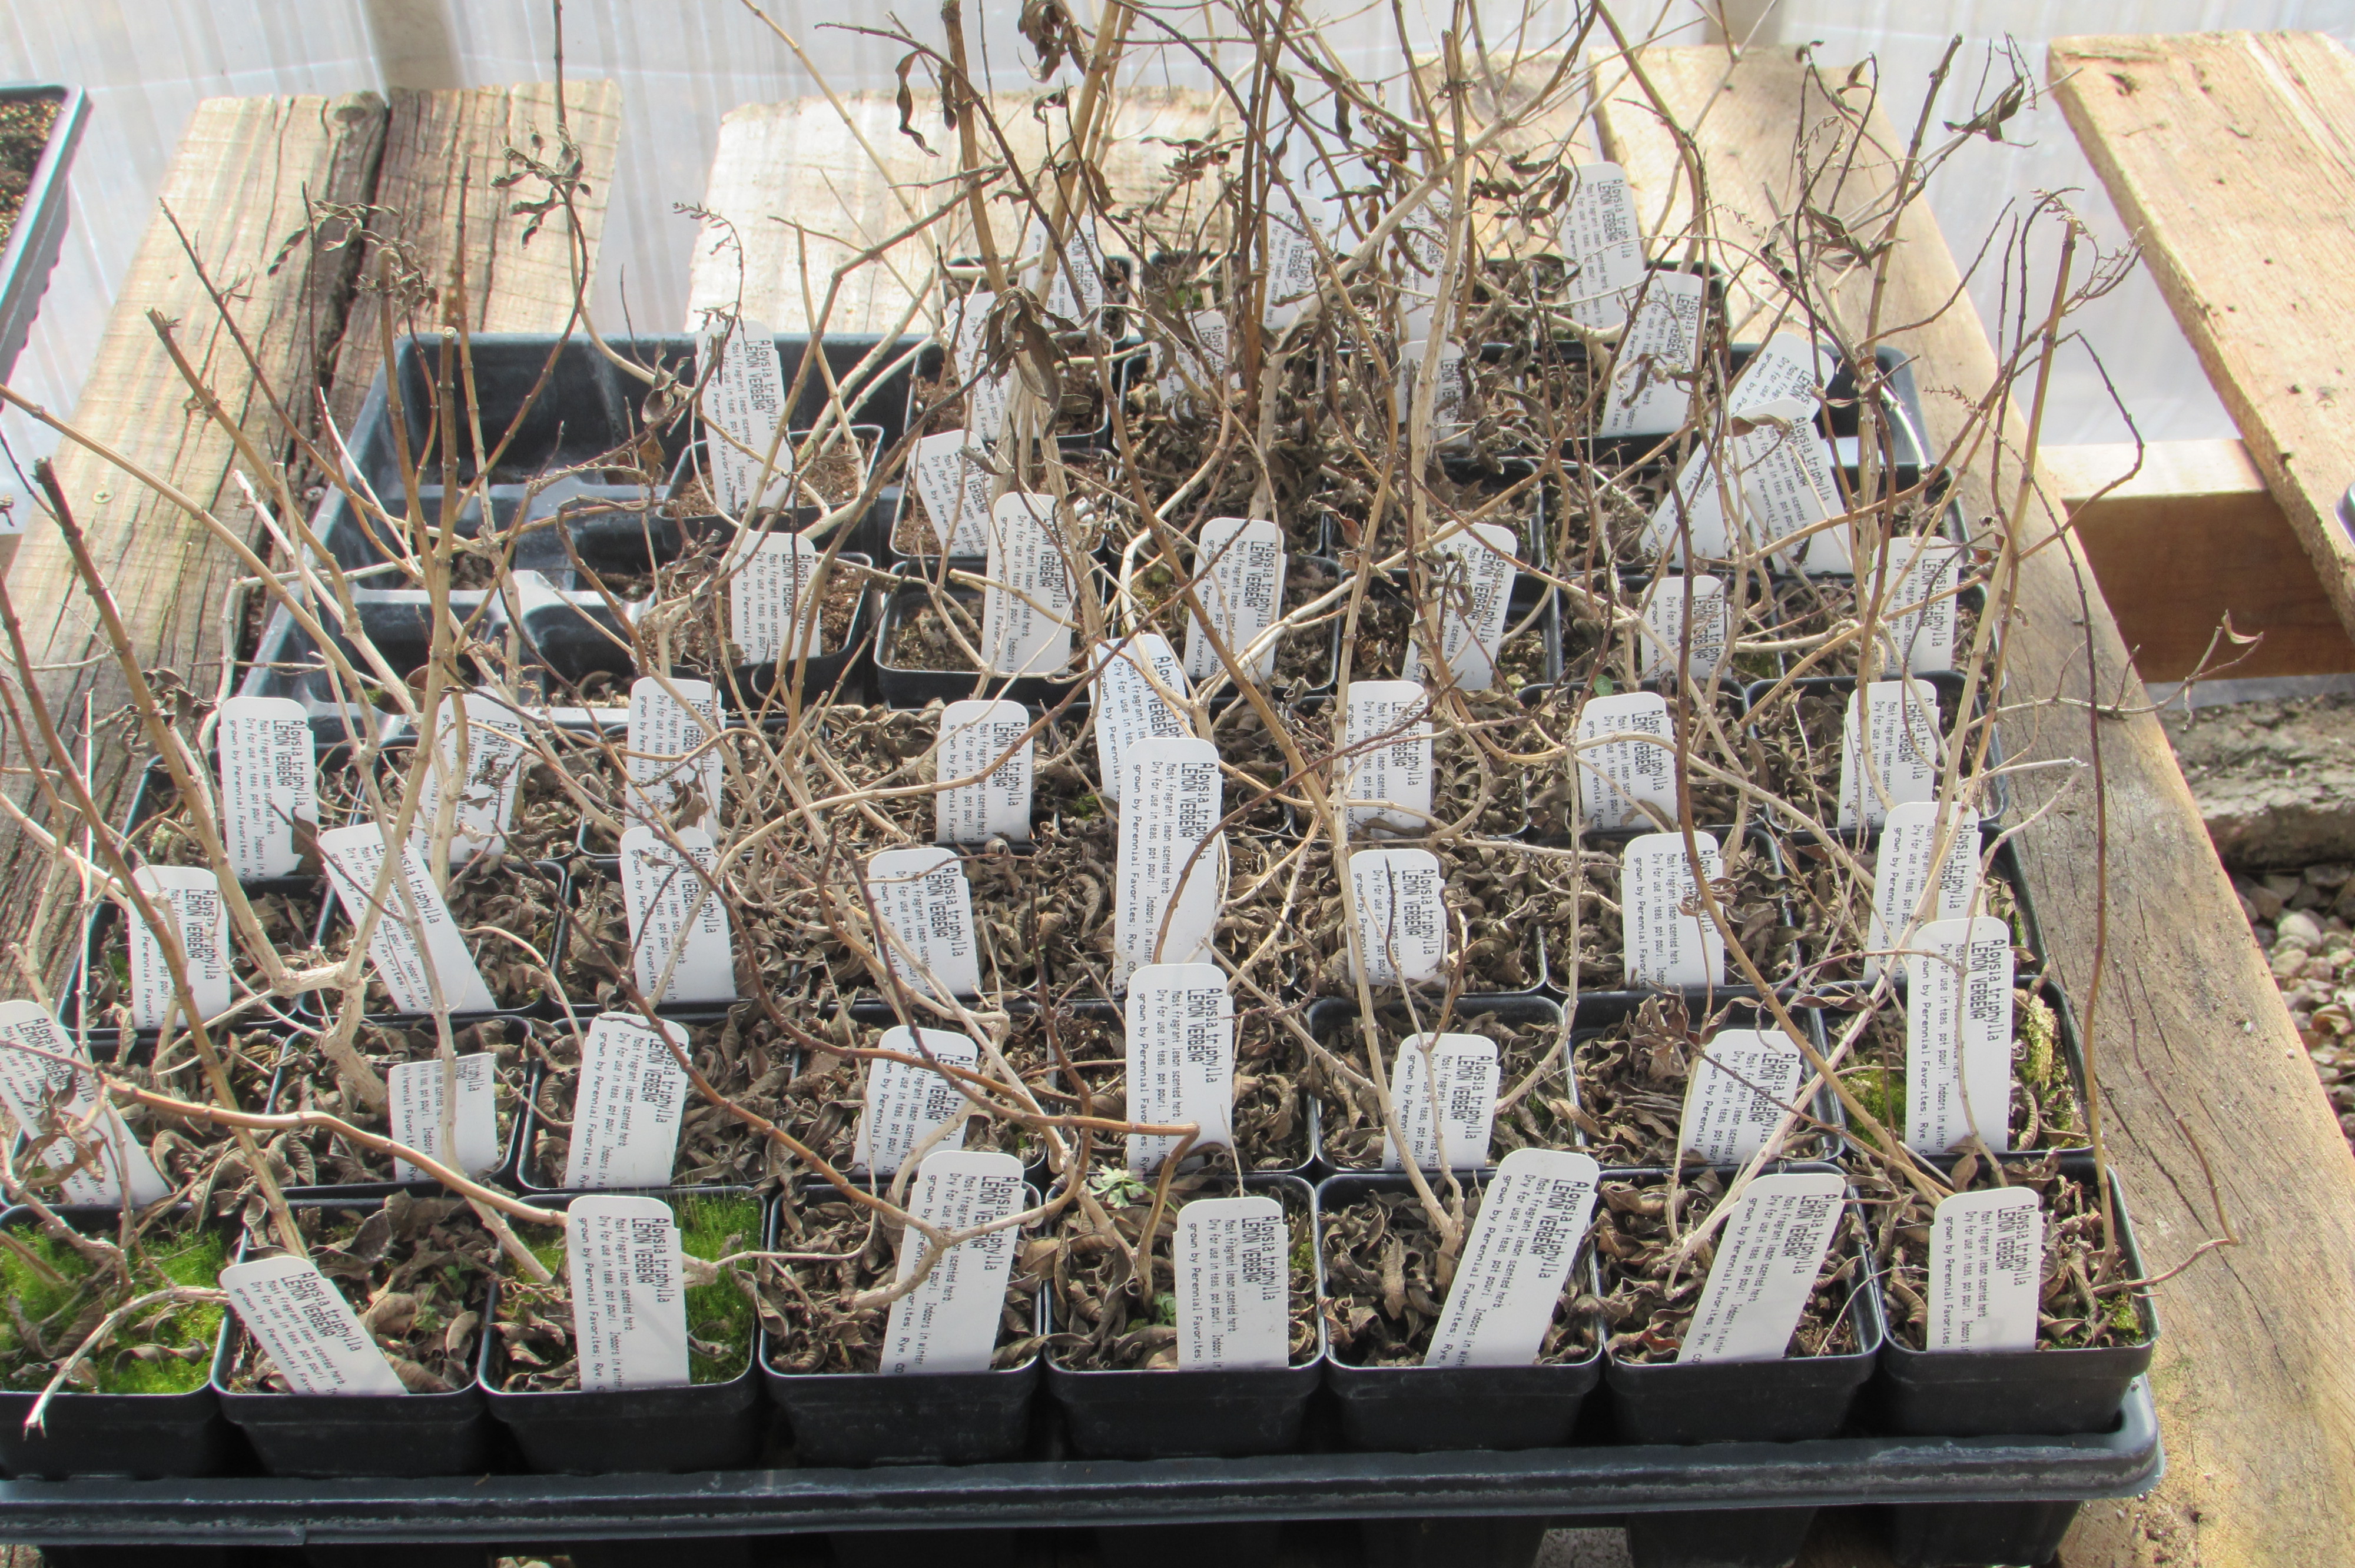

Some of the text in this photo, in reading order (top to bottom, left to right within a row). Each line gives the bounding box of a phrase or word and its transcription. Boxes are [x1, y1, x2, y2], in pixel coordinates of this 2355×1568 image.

[1597, 180, 1613, 206] LEMON
[1611, 179, 1626, 213] Aloysia
[743, 340, 766, 411] LEMON VERBENA
[758, 340, 774, 378] Aloysia
[1745, 351, 1773, 394] grown by
[1784, 364, 1799, 381] Most
[1787, 370, 1814, 400] LEMON
[1793, 417, 1832, 503] Aloysia triphylla
[1039, 551, 1055, 588] VERBENA
[1477, 548, 1498, 577] LEMON
[1243, 573, 1262, 607] VERBENA
[1255, 583, 1275, 628] triphylla
[1929, 600, 1949, 647] triphylla
[273, 720, 293, 787] LEMON VERBENA
[288, 720, 310, 806] Aloysia triphylla
[1150, 761, 1163, 775] Dry
[1648, 748, 1668, 792] triphylla
[1910, 736, 1931, 780] triphylla
[1004, 762, 1024, 807] triphylla
[1132, 765, 1140, 793] grown
[1151, 778, 1162, 790] for
[1166, 763, 1177, 780] Most
[1196, 763, 1215, 803] Aloysia
[1131, 799, 1143, 811] by
[1150, 794, 1158, 808] use
[1163, 784, 1176, 817] fragrant
[1178, 763, 1198, 838] LEMON VERBENA
[1131, 816, 1142, 866] Perennial
[1163, 822, 1175, 842] lemon
[1147, 847, 1158, 859] pot
[1162, 845, 1173, 874] scented
[1402, 870, 1421, 936] LEMON VERBENA
[1947, 865, 1970, 909] triphylla
[185, 889, 204, 959] LEMON VERBENA
[928, 901, 948, 938] VERBENA
[941, 868, 968, 957] Aloysia triphylla
[1145, 896, 1157, 923] Indoors
[1418, 869, 1439, 955] Aloysia triphylla
[1127, 961, 1135, 973] CO
[1143, 939, 1154, 961] winter
[1969, 977, 1988, 1020] VERBENA
[1983, 939, 2006, 1042] Aloysia triphylla
[1187, 989, 1205, 1062] LEMON VERBENA
[641, 1038, 666, 1103] LEMON VERBENA
[1202, 1033, 1222, 1084] triphylla
[1757, 1053, 1780, 1080] LEMON
[1773, 1054, 1797, 1091] Aloysia
[654, 1081, 678, 1124] triphylla
[1450, 1055, 1475, 1120] LEMON VERBENA
[1462, 1055, 1493, 1140] Aloysia triphylla
[977, 1176, 1001, 1205] LEMON
[995, 1177, 1020, 1216] Aloysia
[1766, 1195, 1782, 1206] Dry
[1782, 1196, 1797, 1210] Most
[598, 1216, 611, 1228] Dry
[615, 1218, 628, 1233] Most
[1528, 1180, 1573, 1255] LEMON VERBENA
[1743, 1198, 1757, 1222] grown
[1758, 1222, 1769, 1233] use
[1763, 1209, 1777, 1219] for
[1770, 1213, 1792, 1240] fragrant
[1780, 1195, 1820, 1257] LEMON VERBENA
[577, 1218, 589, 1243] grown
[600, 1231, 612, 1241] for
[1538, 1181, 1590, 1278] Aloysia triphylla
[1737, 1226, 1751, 1237] by
[1995, 1207, 2016, 1271] LEMON VERBENA
[2010, 1204, 2035, 1286] Aloysia triphylla
[581, 1248, 593, 1259] by
[601, 1245, 611, 1256] use
[615, 1237, 630, 1265] fragrant
[632, 1218, 655, 1284] LEMON VERBENA
[650, 1218, 675, 1303] Aloysia triphylla
[1242, 1217, 1261, 1283] LEMON VERBENA
[1258, 1216, 1281, 1301] Aloysia triphylla
[1722, 1240, 1746, 1281] Perennial
[1763, 1244, 1780, 1261] lemon
[1792, 1232, 1824, 1274] triphylla
[584, 1263, 598, 1306] Perennial
[619, 1269, 631, 1287] lemon
[1742, 1265, 1753, 1275] pot
[1753, 1264, 1769, 1287] scented
[280, 1275, 336, 1338] LEMON VERBENA
[298, 1272, 363, 1352] Aloysia triphylla
[603, 1290, 617, 1301] pot
[621, 1290, 634, 1314] scented
[1723, 1304, 1742, 1325] Indoors
[609, 1332, 621, 1354] Indoors
[1713, 1336, 1727, 1354] winter
[612, 1367, 623, 1388] winter
